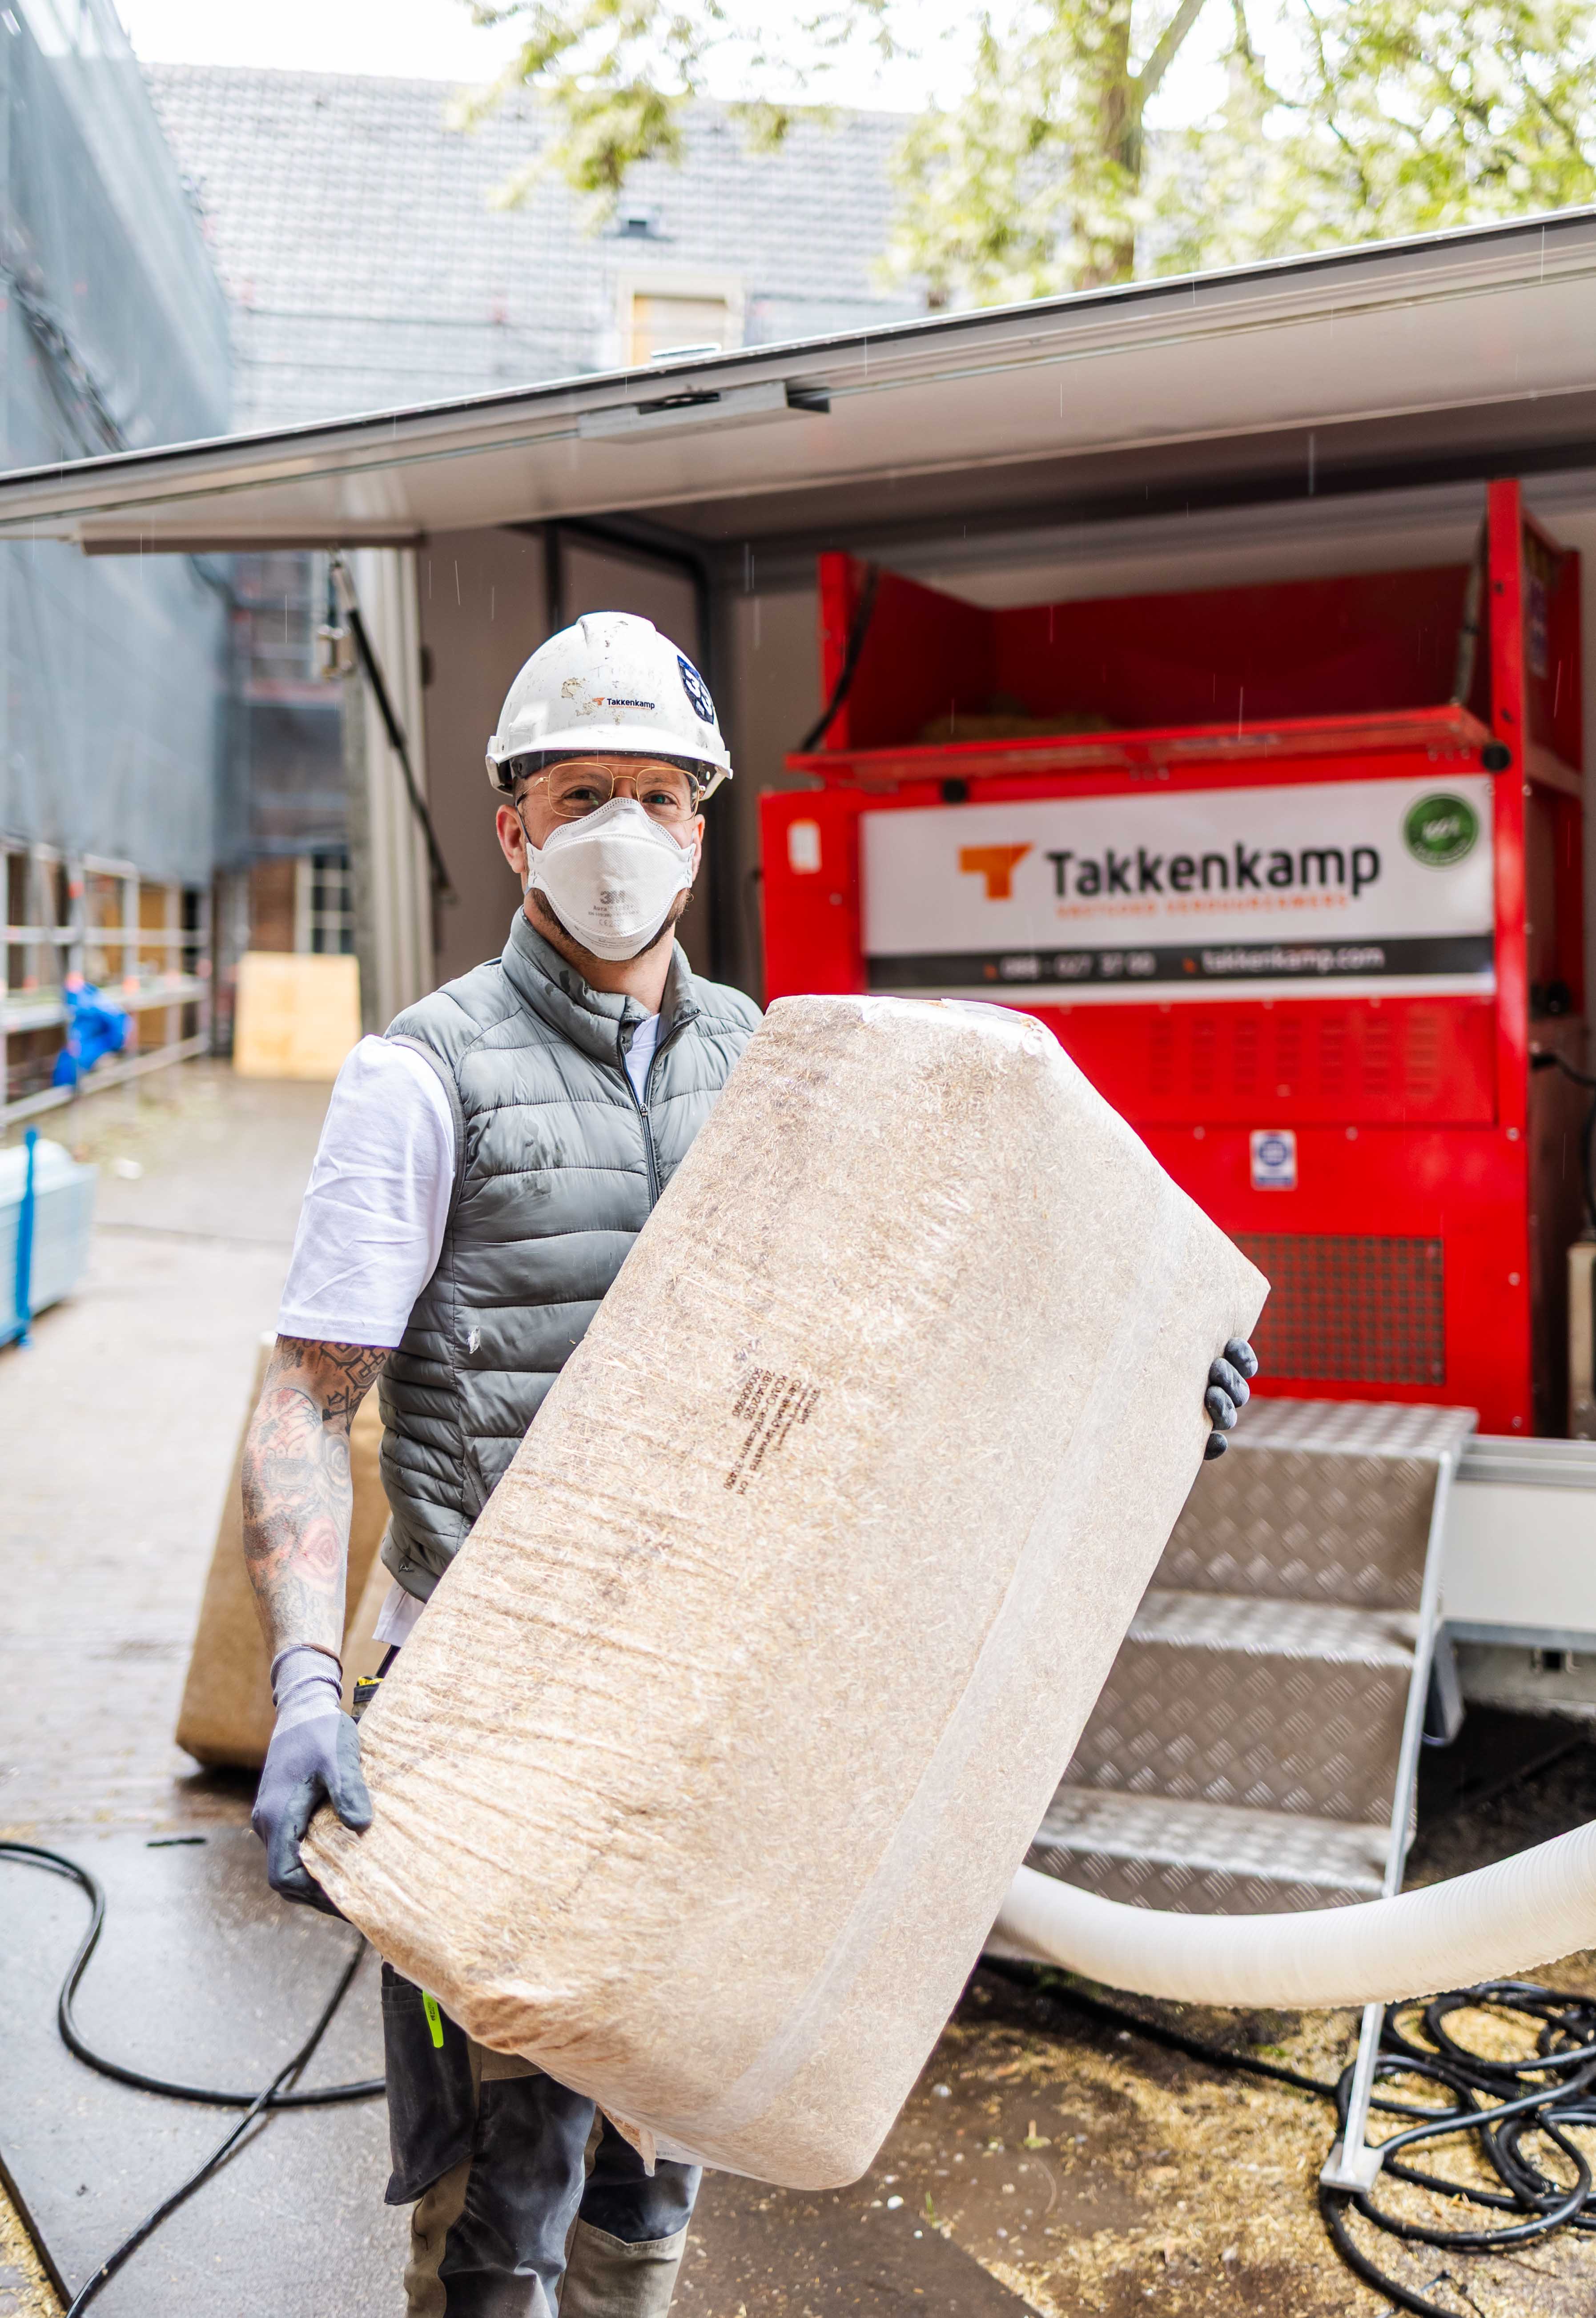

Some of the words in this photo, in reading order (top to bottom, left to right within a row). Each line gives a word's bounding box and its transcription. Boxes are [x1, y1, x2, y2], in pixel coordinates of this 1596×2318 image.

[607, 698, 655, 710] Takkenkamp
[1046, 842, 1380, 897] Takkenkamp
[599, 890, 626, 904] 3M
[1202, 945, 1385, 974] takkenkamp.com
